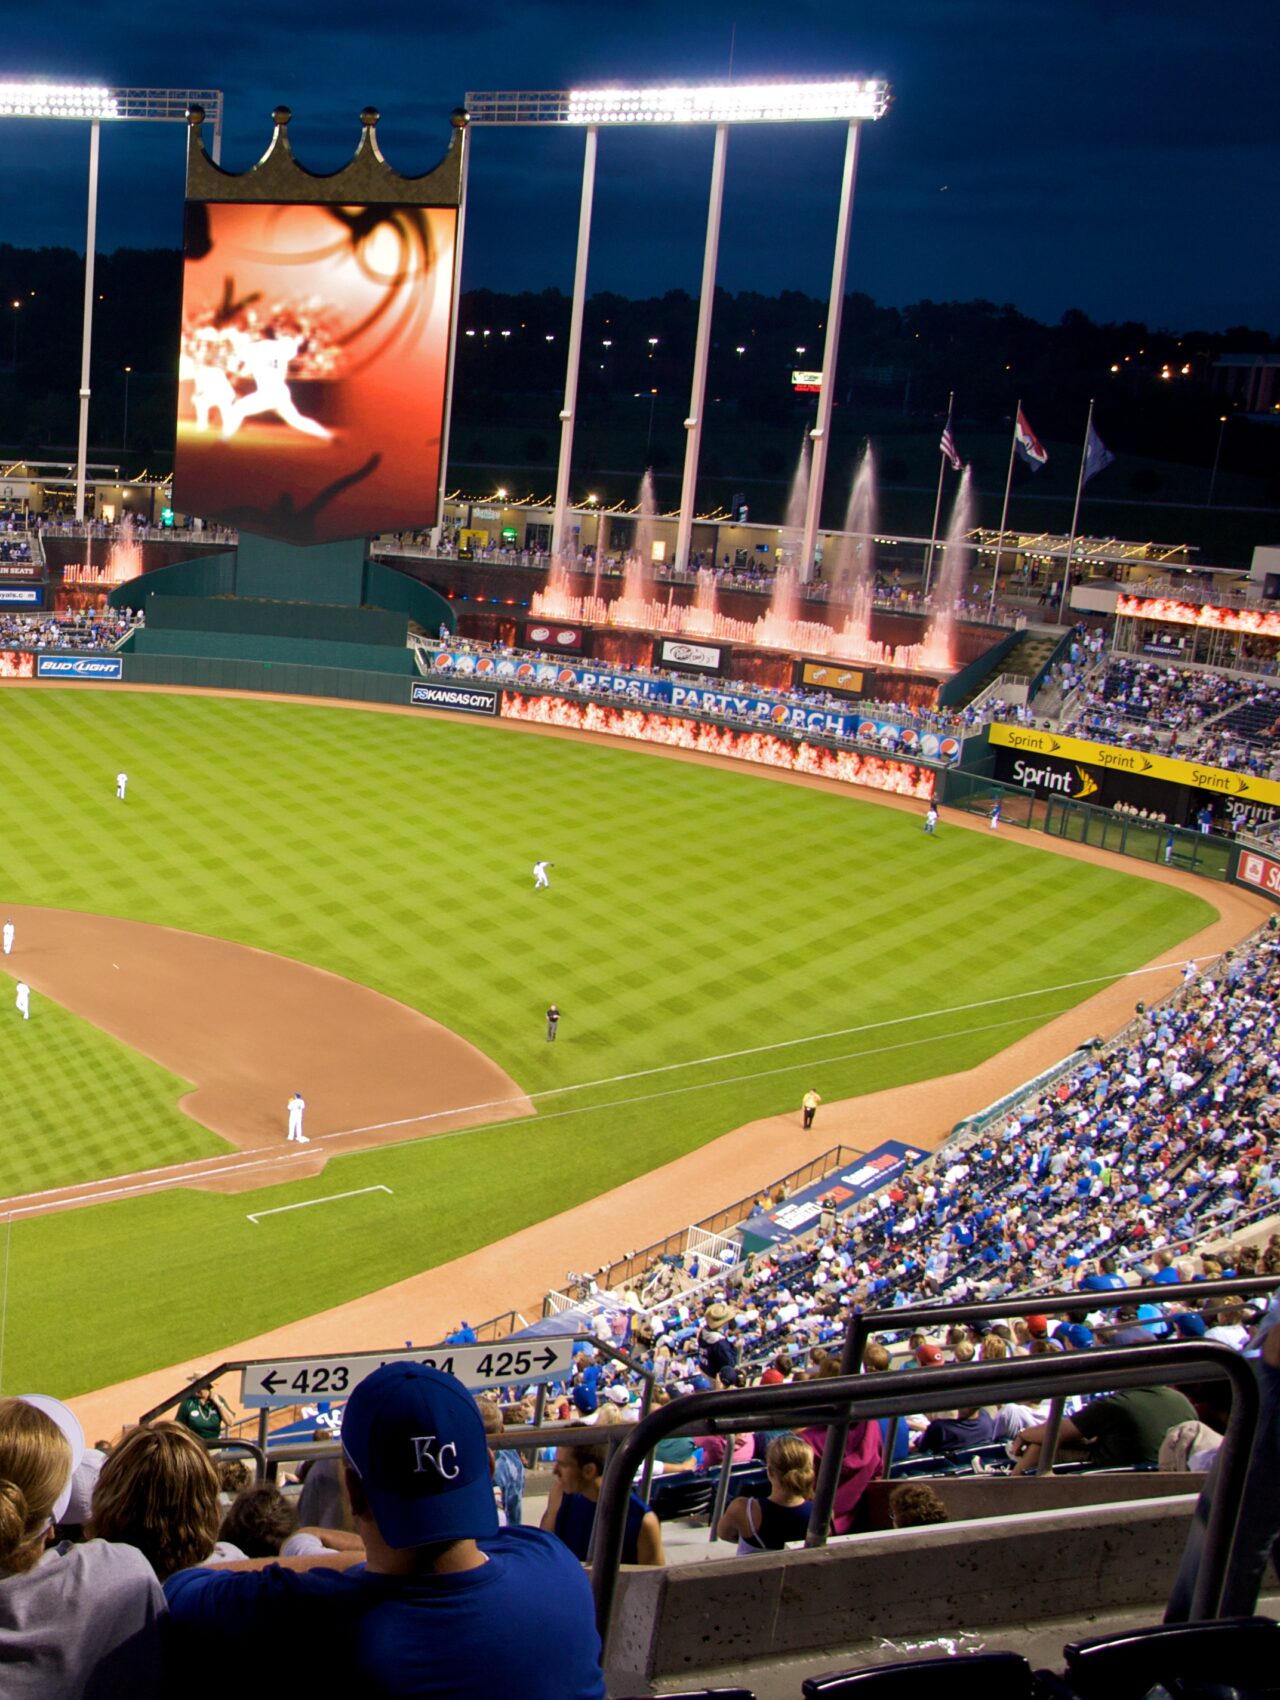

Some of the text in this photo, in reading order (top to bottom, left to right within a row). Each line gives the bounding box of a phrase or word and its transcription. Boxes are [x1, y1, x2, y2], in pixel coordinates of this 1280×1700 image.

[9, 567, 34, 575] SEATS
[40, 661, 119, 672] BUD LIGHT
[583, 672, 845, 731] PEPSI PARTY PORCH
[1007, 732, 1044, 750] Sprint
[1097, 750, 1135, 769] Sprint
[1012, 760, 1073, 794] Sprint
[1191, 770, 1230, 790] Sprint
[1225, 796, 1277, 822] Sprint
[476, 1350, 532, 1379] 425
[291, 1366, 350, 1394] 423
[410, 1435, 460, 1480] KC
